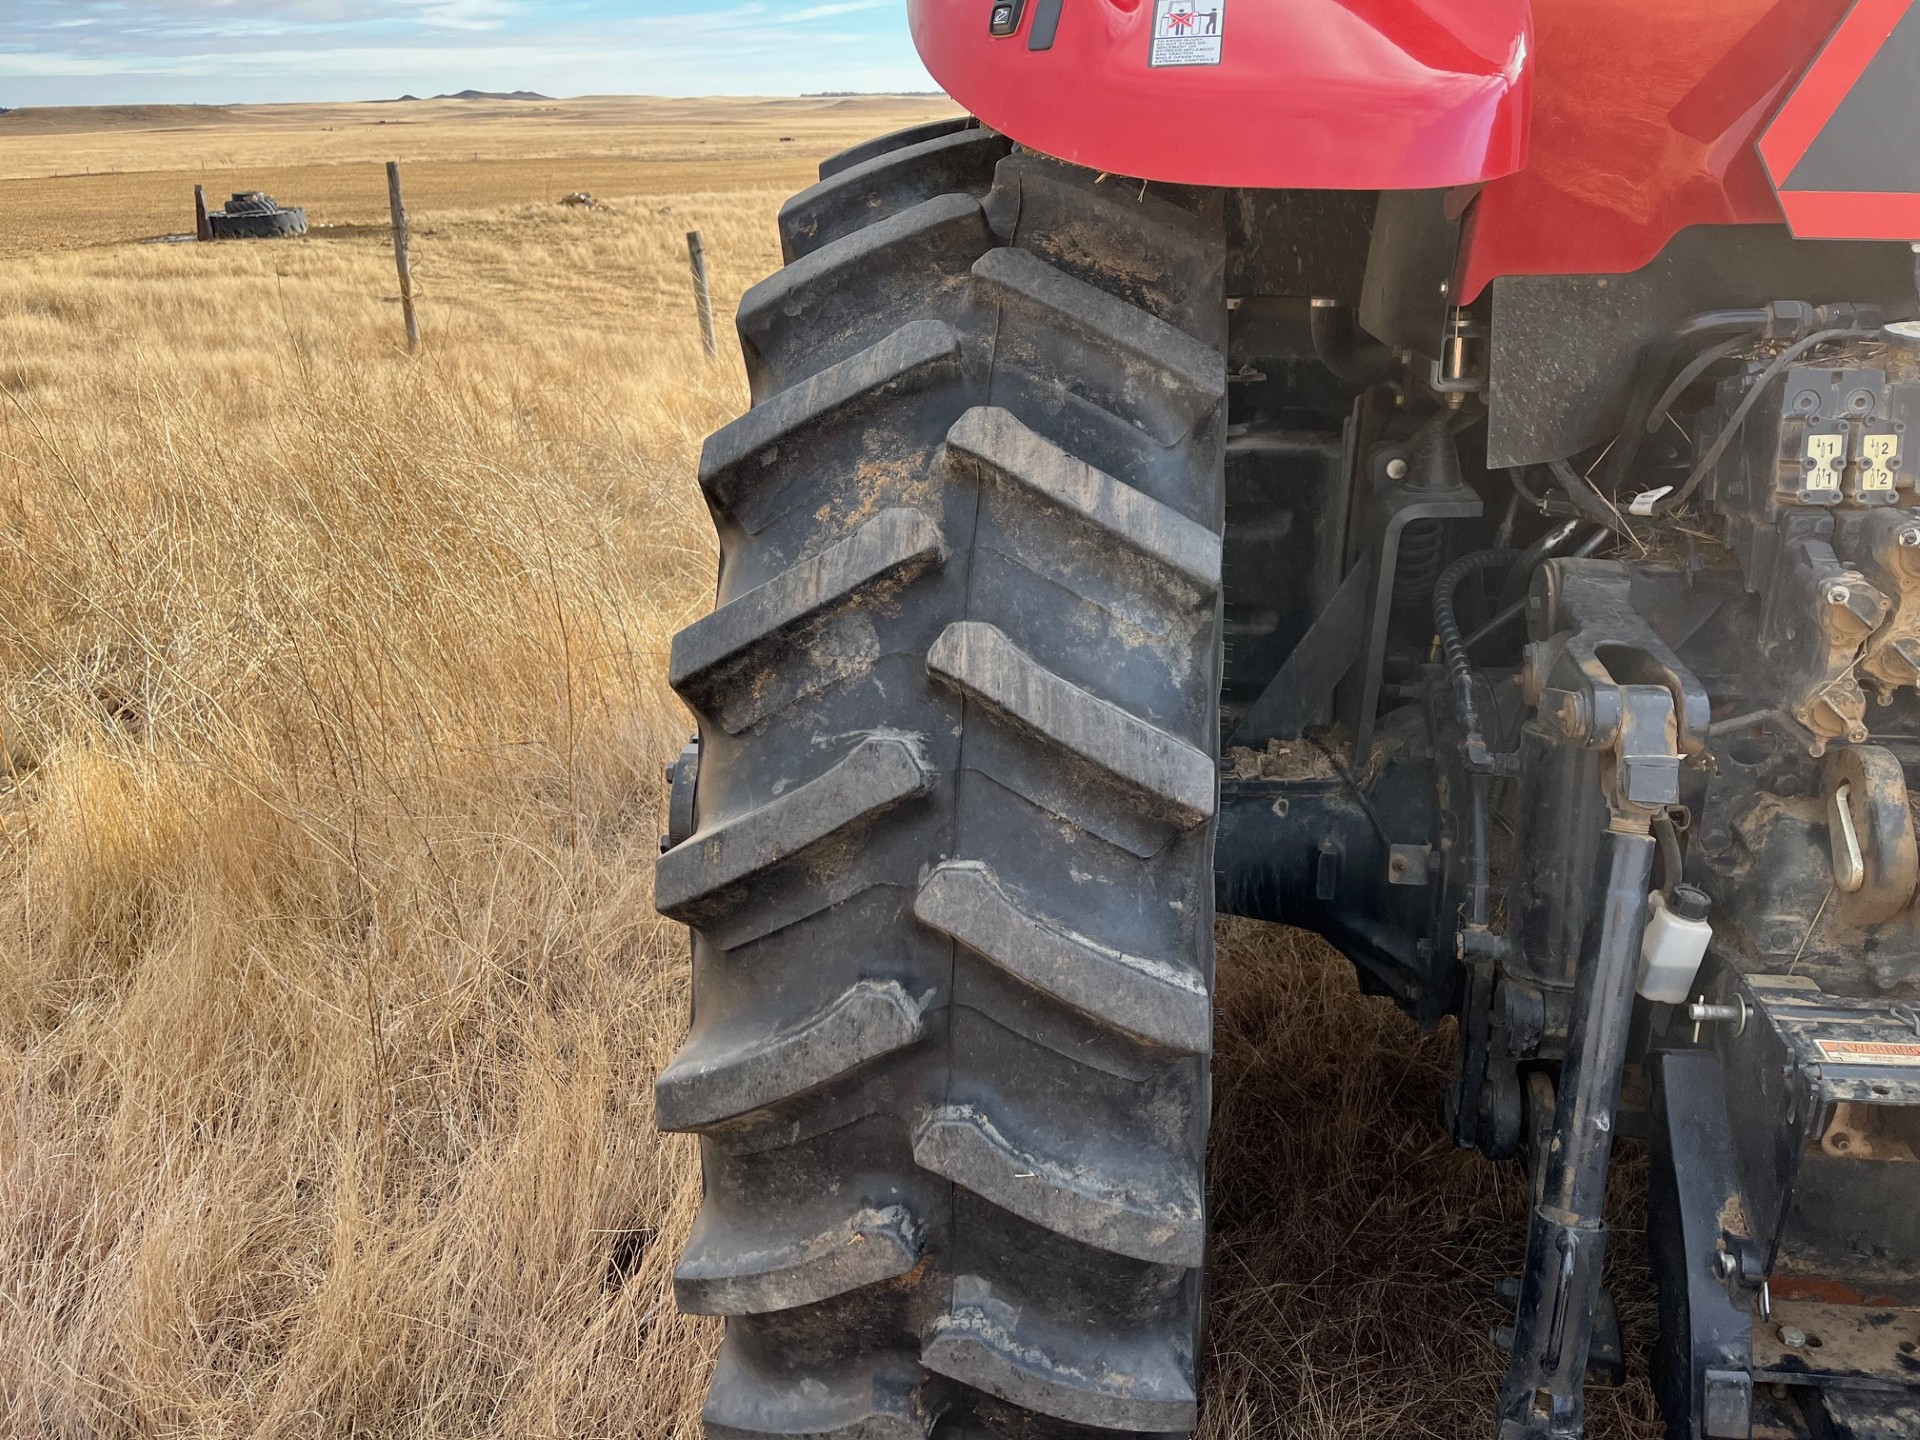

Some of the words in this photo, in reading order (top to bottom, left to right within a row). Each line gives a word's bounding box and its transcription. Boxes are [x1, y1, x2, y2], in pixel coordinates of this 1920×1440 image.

[1828, 442, 1833, 454] 1
[1881, 442, 1889, 454] 2
[1826, 472, 1831, 484] 1
[1880, 472, 1887, 484] 2
[1849, 1044, 1920, 1054] WARNING
